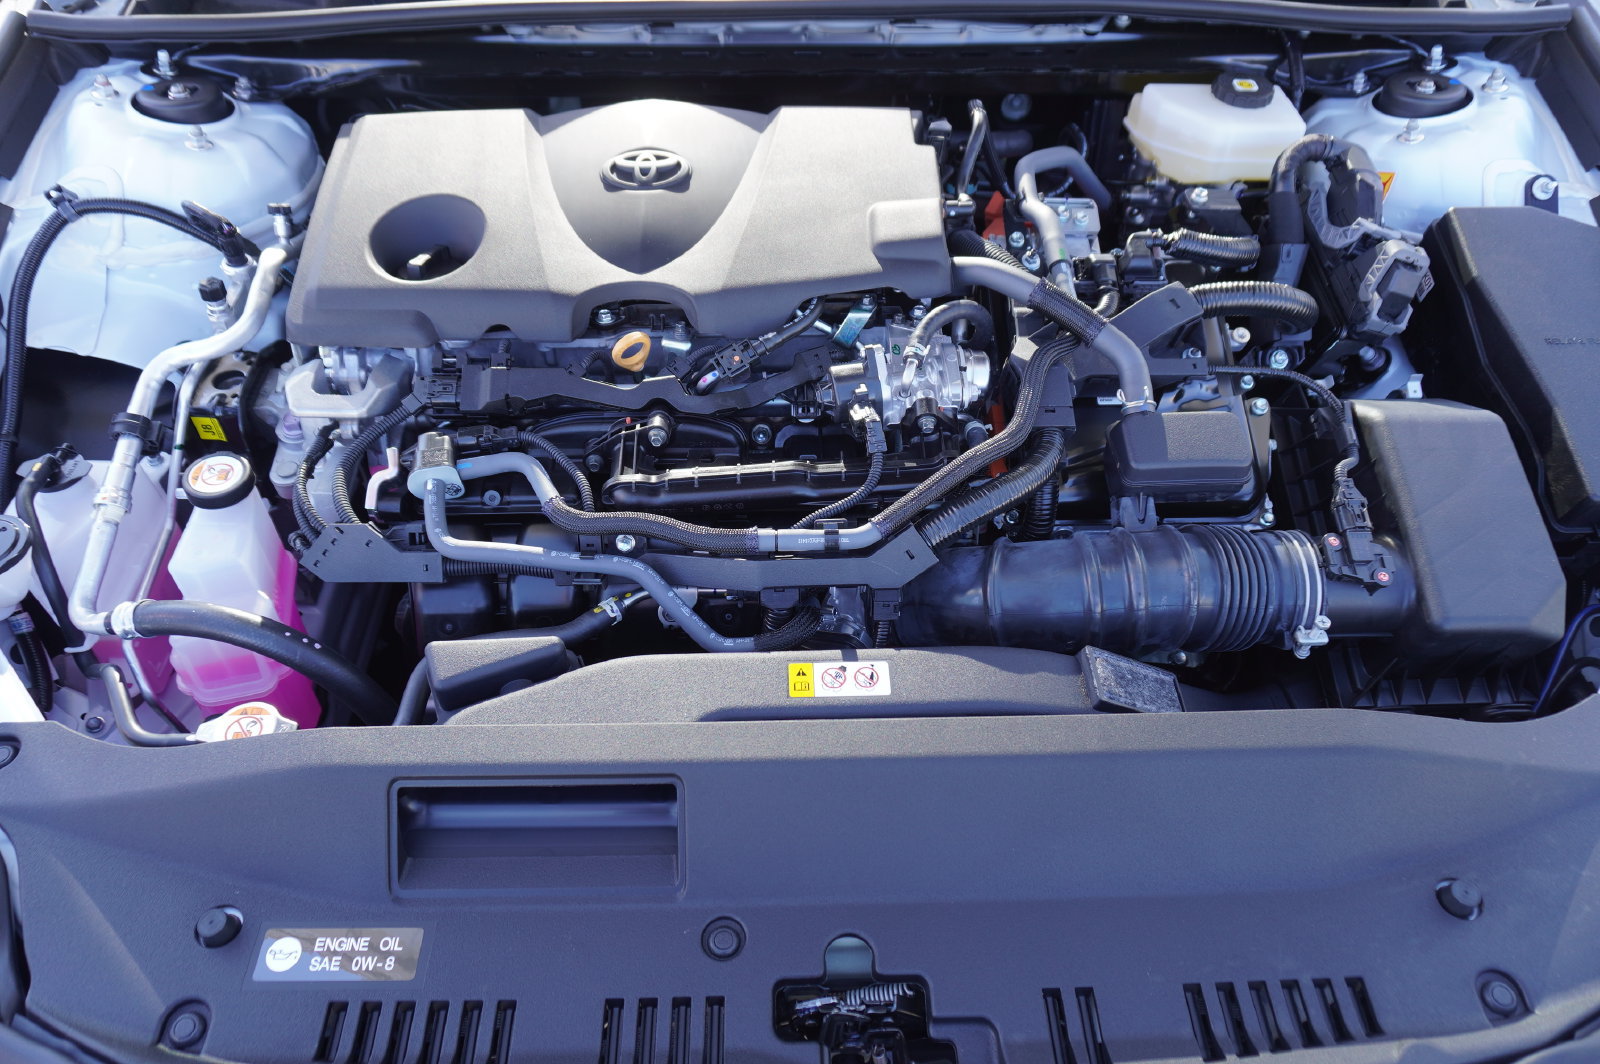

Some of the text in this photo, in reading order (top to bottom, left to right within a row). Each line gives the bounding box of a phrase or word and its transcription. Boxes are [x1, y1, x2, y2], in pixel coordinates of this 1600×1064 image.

[313, 936, 403, 951] ENGINE OIL
[309, 956, 395, 971] SAE 0W-8
